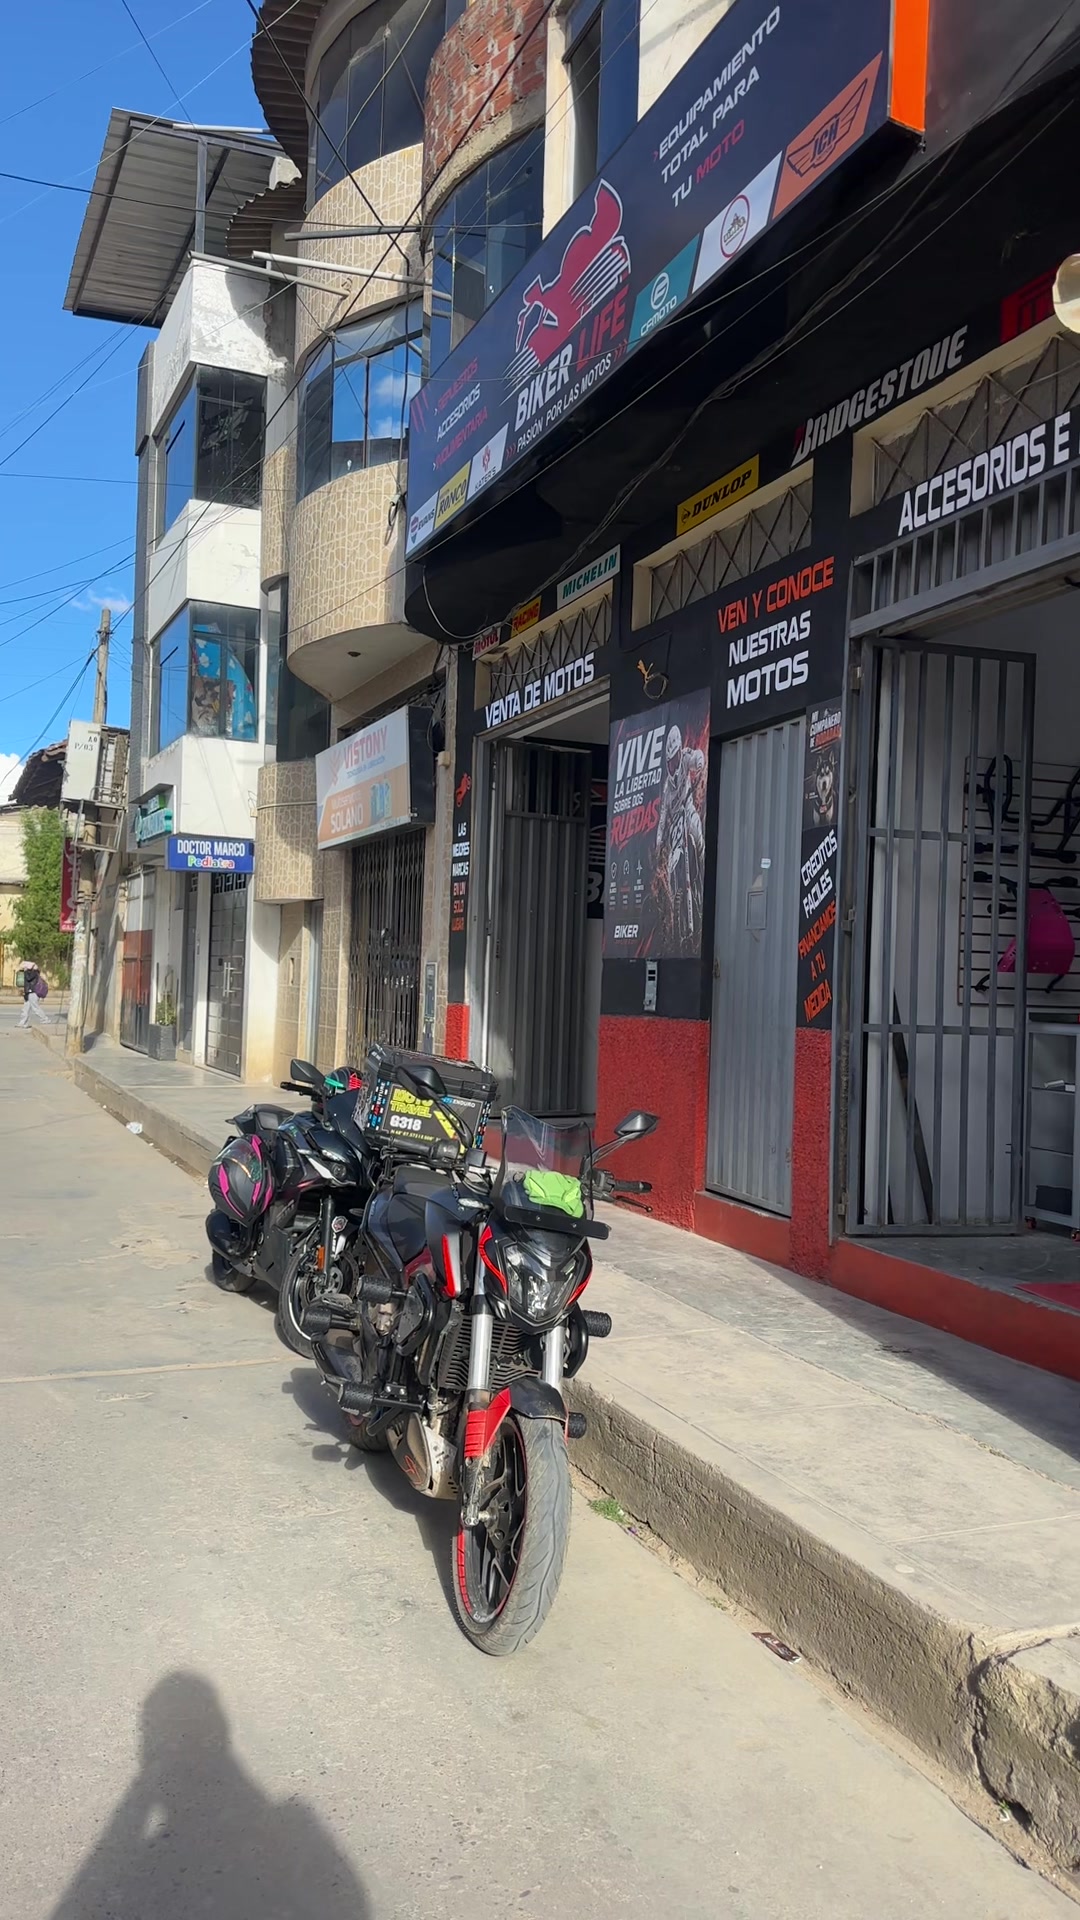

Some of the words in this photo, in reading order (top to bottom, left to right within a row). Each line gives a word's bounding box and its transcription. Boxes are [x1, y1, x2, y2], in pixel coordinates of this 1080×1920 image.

[659, 5, 780, 160] EQUIPAMIENTO
[661, 126, 708, 184] TOTAL
[712, 65, 760, 129] PARA
[672, 175, 692, 208] TU
[696, 119, 745, 183] MOTO
[640, 295, 677, 337] CFMOTO
[515, 344, 572, 432] BIKER
[576, 284, 629, 372] LIFE
[437, 357, 478, 411] REPUESTOS
[517, 418, 543, 453] PASIÓN
[546, 403, 562, 427] POR
[563, 385, 579, 411] LAS
[580, 352, 612, 393] MOTOS
[437, 383, 480, 442] ACCESORIOS
[435, 407, 488, 470] INDUMENTARIA
[437, 478, 467, 518] RONCO
[692, 469, 752, 518] DUNLOP
[898, 423, 1046, 537] ACCESORIOS
[1053, 411, 1070, 465] E
[563, 552, 617, 599] MICHELIN
[717, 600, 747, 634] VEN
[750, 590, 764, 618] Y
[766, 556, 835, 614] CONOCE
[513, 602, 539, 631] RACING
[729, 609, 811, 668] NUESTRAS
[474, 629, 499, 655] MOTUL
[485, 690, 521, 729] VENTA
[524, 679, 542, 712] DE
[544, 652, 595, 702] MOTOS
[726, 650, 809, 710] MOTOS
[344, 725, 388, 769] VISTONY
[616, 724, 666, 782] VIVE
[613, 796, 632, 814] SOBRE
[632, 792, 644, 808] DOS
[614, 781, 625, 799] LA
[626, 767, 662, 795] LIBERTAD
[330, 803, 364, 835] SOLANO
[458, 822, 467, 837] LAS
[610, 797, 660, 848] RUEDAS
[177, 839, 212, 855] DOCTOR
[214, 841, 245, 857] MARCO
[187, 855, 235, 869] Pediatra
[801, 829, 837, 887] CREDITOS
[803, 868, 833, 919] FACILES
[614, 924, 638, 939] BIKER
[811, 961, 817, 981] A
[815, 949, 826, 973] TU
[390, 1100, 432, 1119] TRAVEL
[452, 1099, 476, 1108] ENDURO
